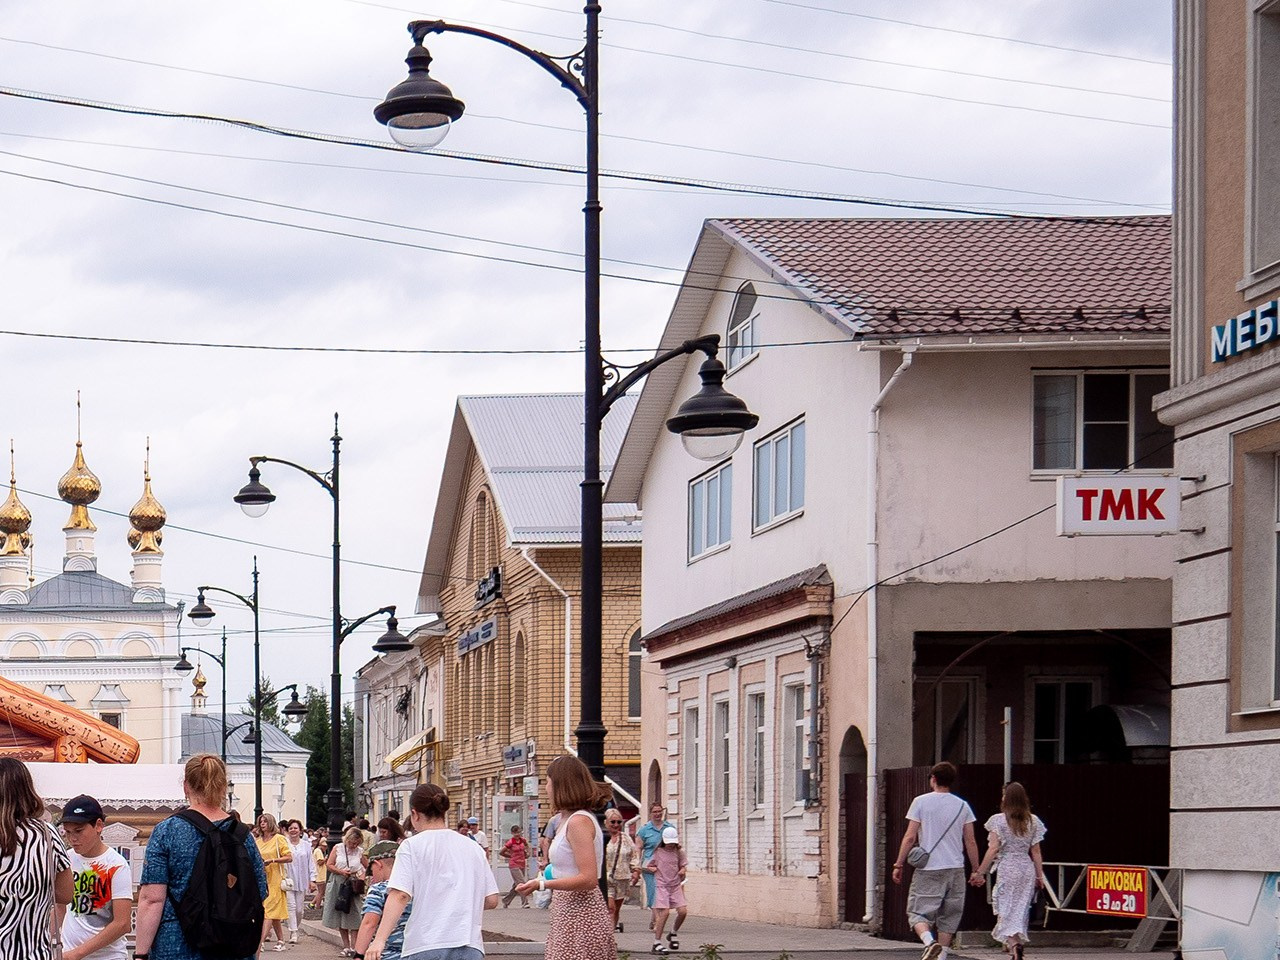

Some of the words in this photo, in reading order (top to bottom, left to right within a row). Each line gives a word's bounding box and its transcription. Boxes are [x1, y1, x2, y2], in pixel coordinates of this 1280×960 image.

[1211, 296, 1280, 363] МЕБ
[1076, 488, 1166, 521] ТМК
[73, 867, 112, 898] RBAN
[1090, 870, 1143, 892] ПАРКОВКА
[1103, 893, 1110, 909] 9
[1122, 894, 1136, 912] 20
